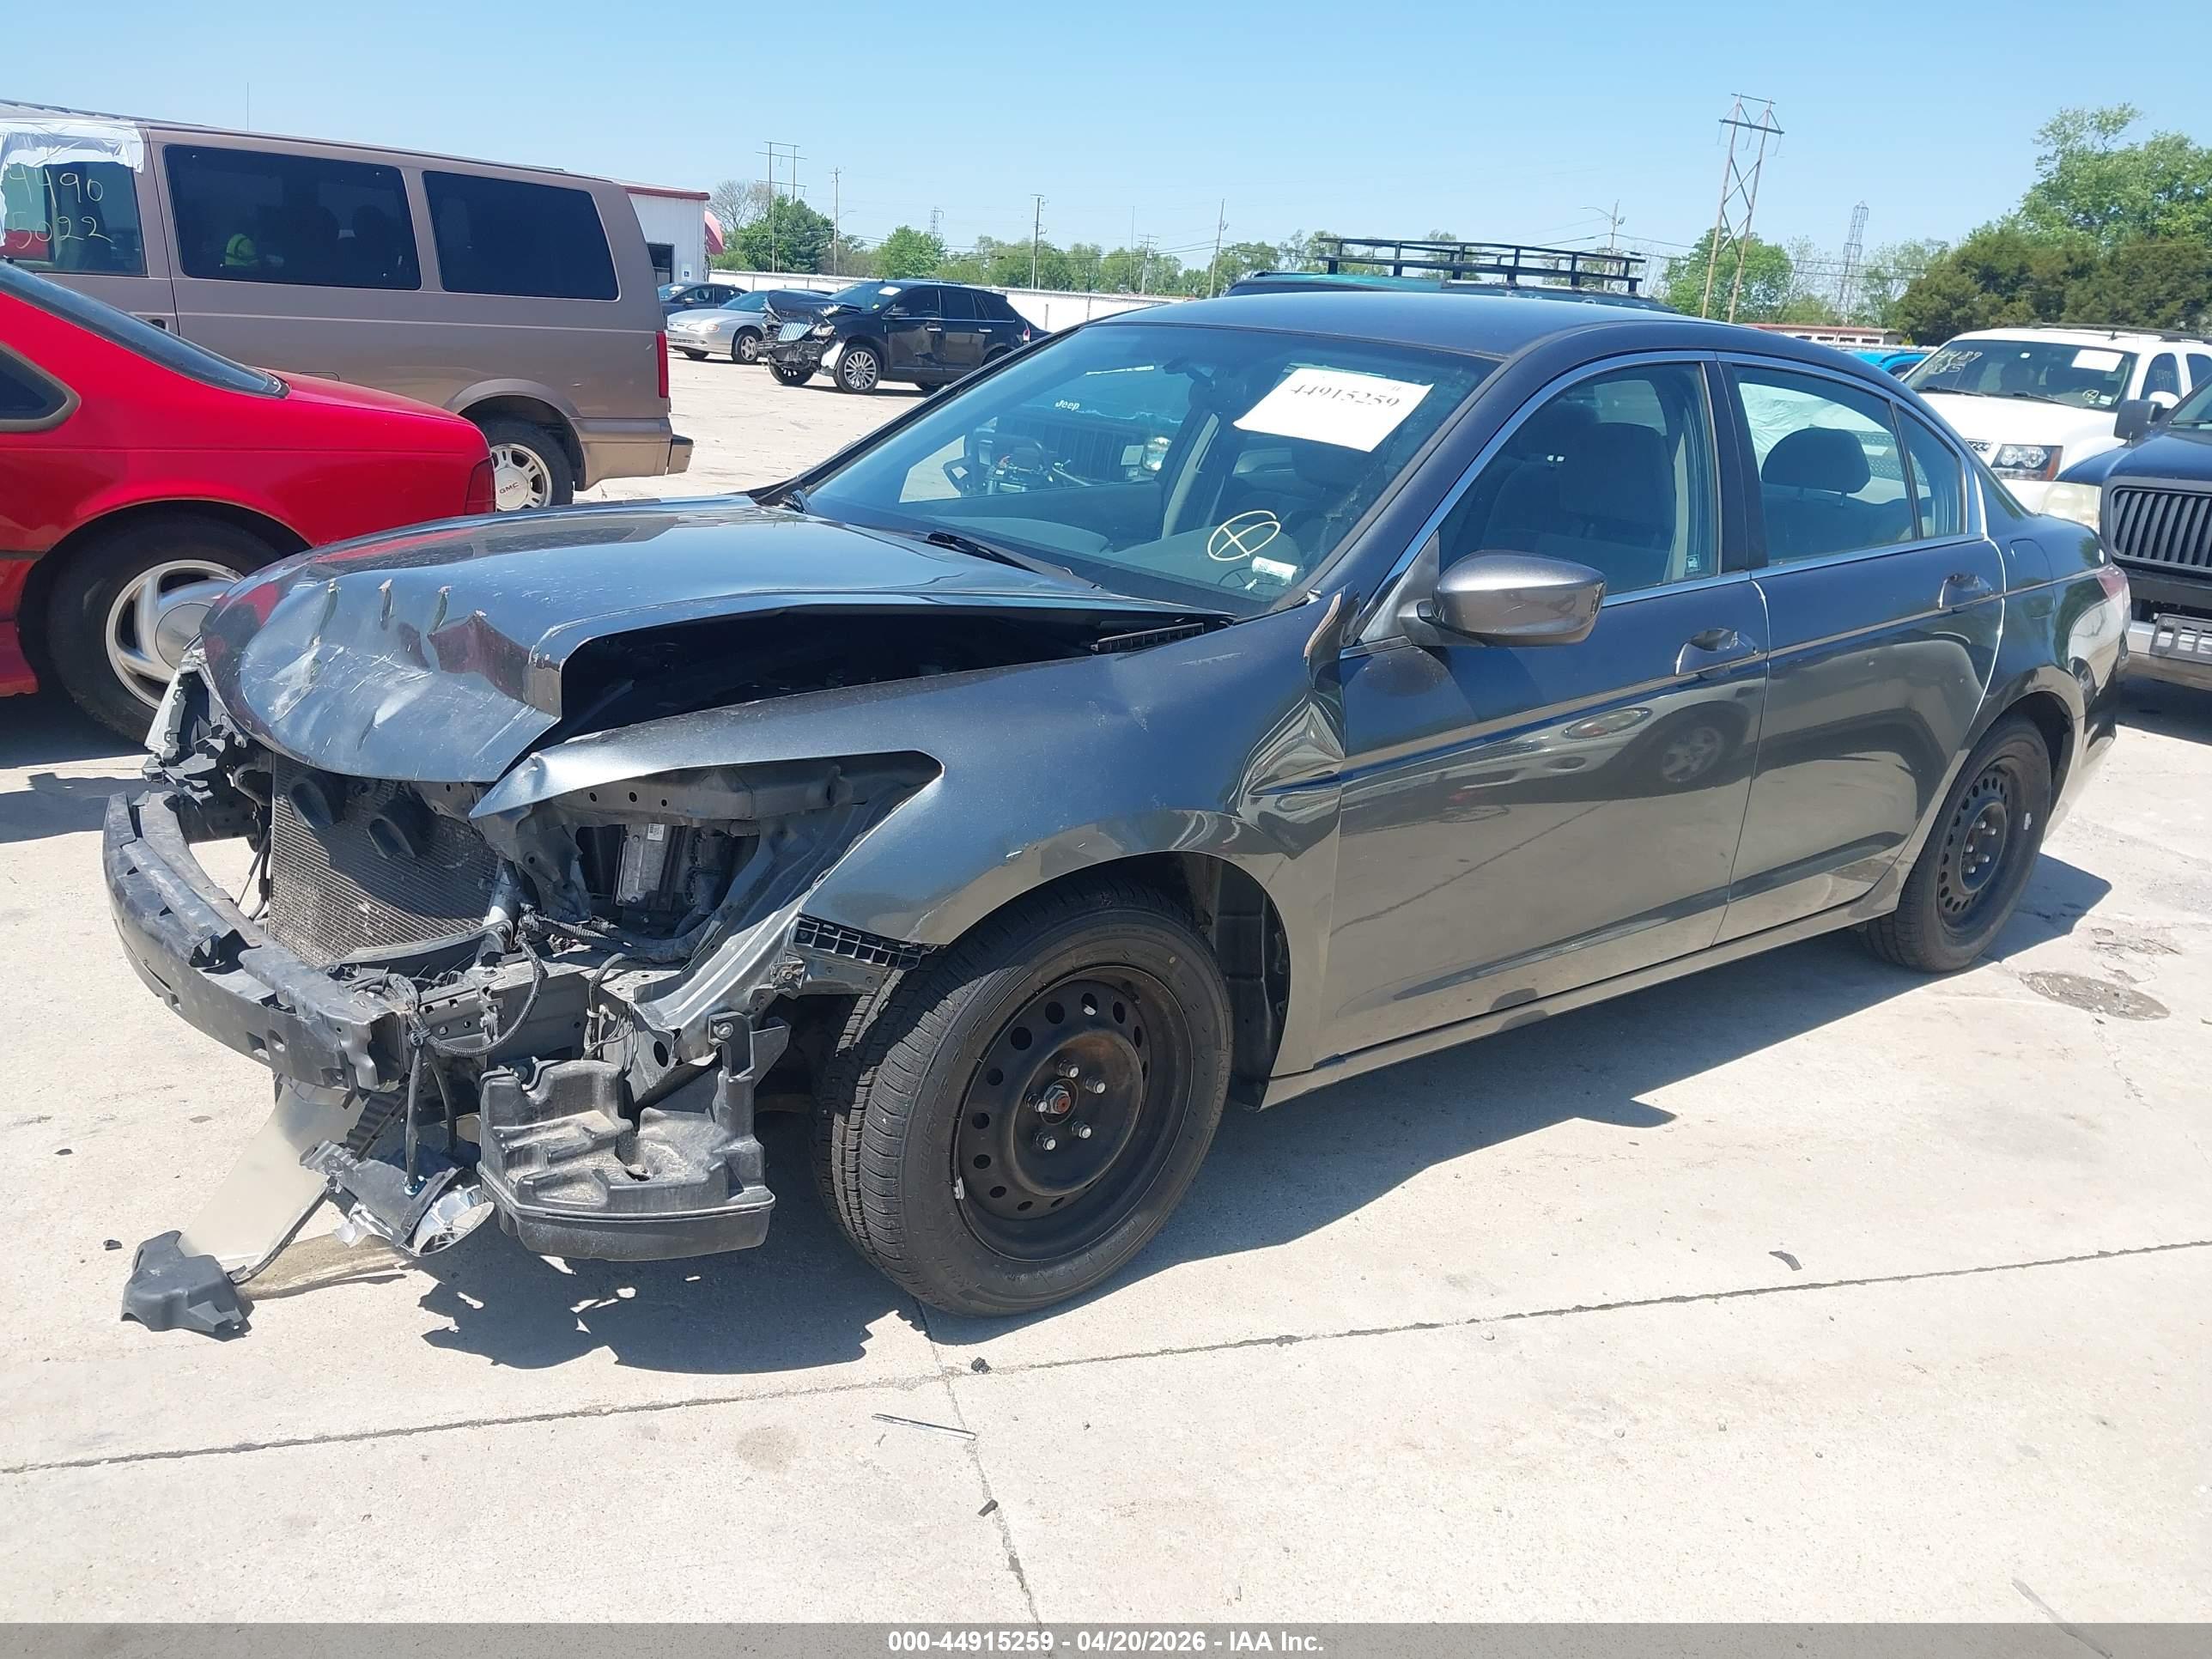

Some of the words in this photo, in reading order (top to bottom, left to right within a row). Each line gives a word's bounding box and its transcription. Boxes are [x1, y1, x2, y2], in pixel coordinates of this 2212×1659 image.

[9, 165, 104, 209] 4490
[10, 211, 114, 249] 5022
[1054, 399, 1080, 411] Jeep
[1290, 384, 1401, 407] 44915259
